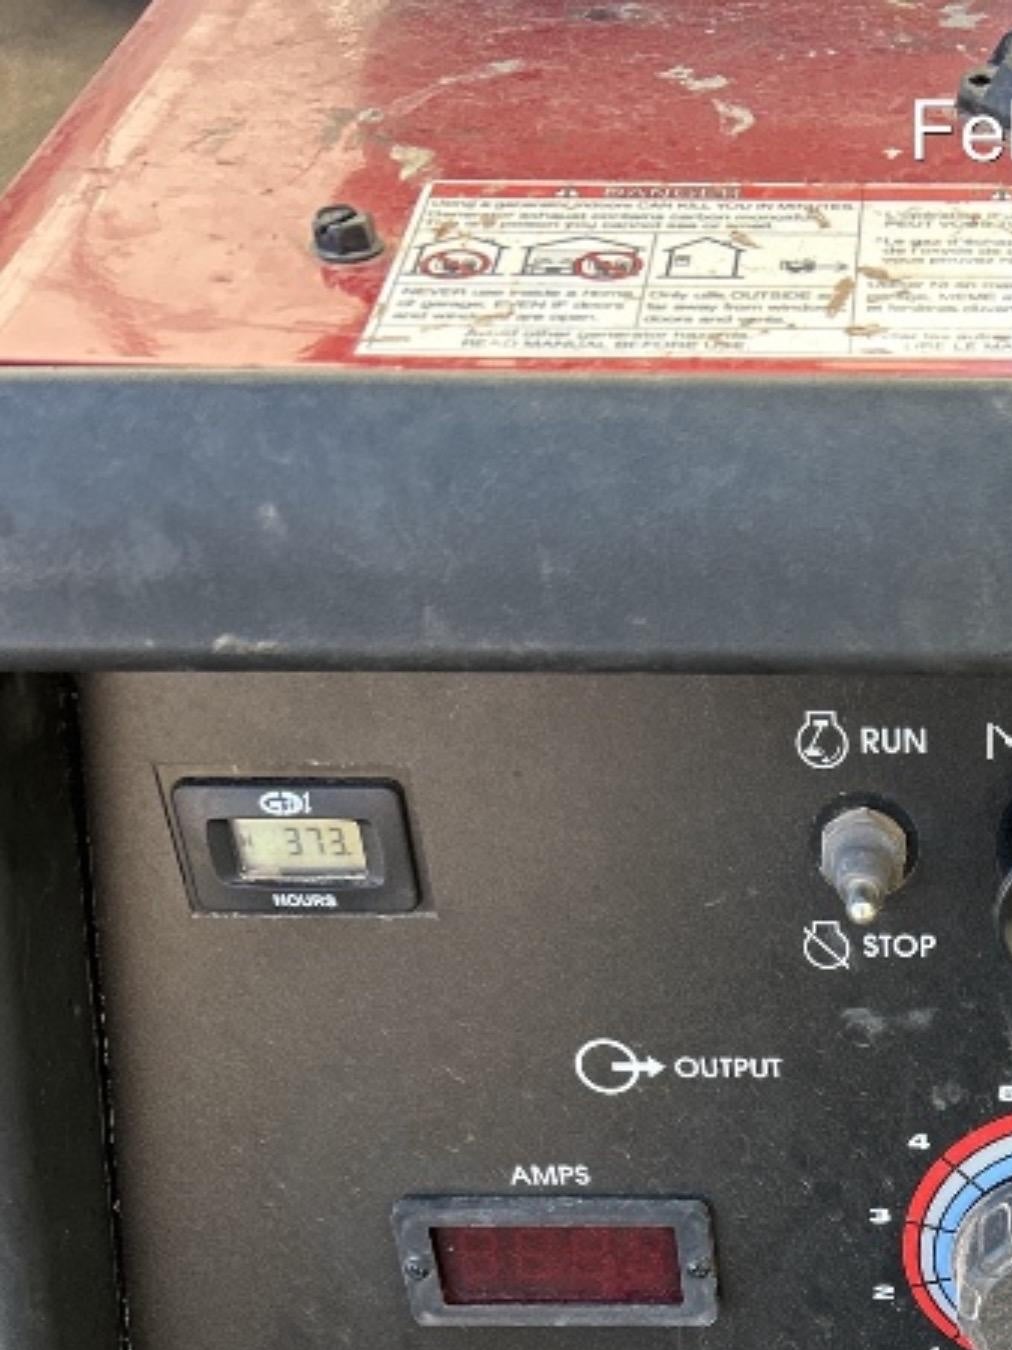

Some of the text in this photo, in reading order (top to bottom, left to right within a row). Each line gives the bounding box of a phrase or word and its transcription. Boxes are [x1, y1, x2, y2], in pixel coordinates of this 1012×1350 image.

[859, 728, 928, 755] RUN
[862, 932, 937, 958] STOP
[673, 1056, 794, 1079] OUTPUT
[907, 1134, 931, 1150] 4
[510, 1164, 591, 1186] AMPS
[869, 1209, 892, 1224] 3
[872, 1285, 896, 1300] 2
